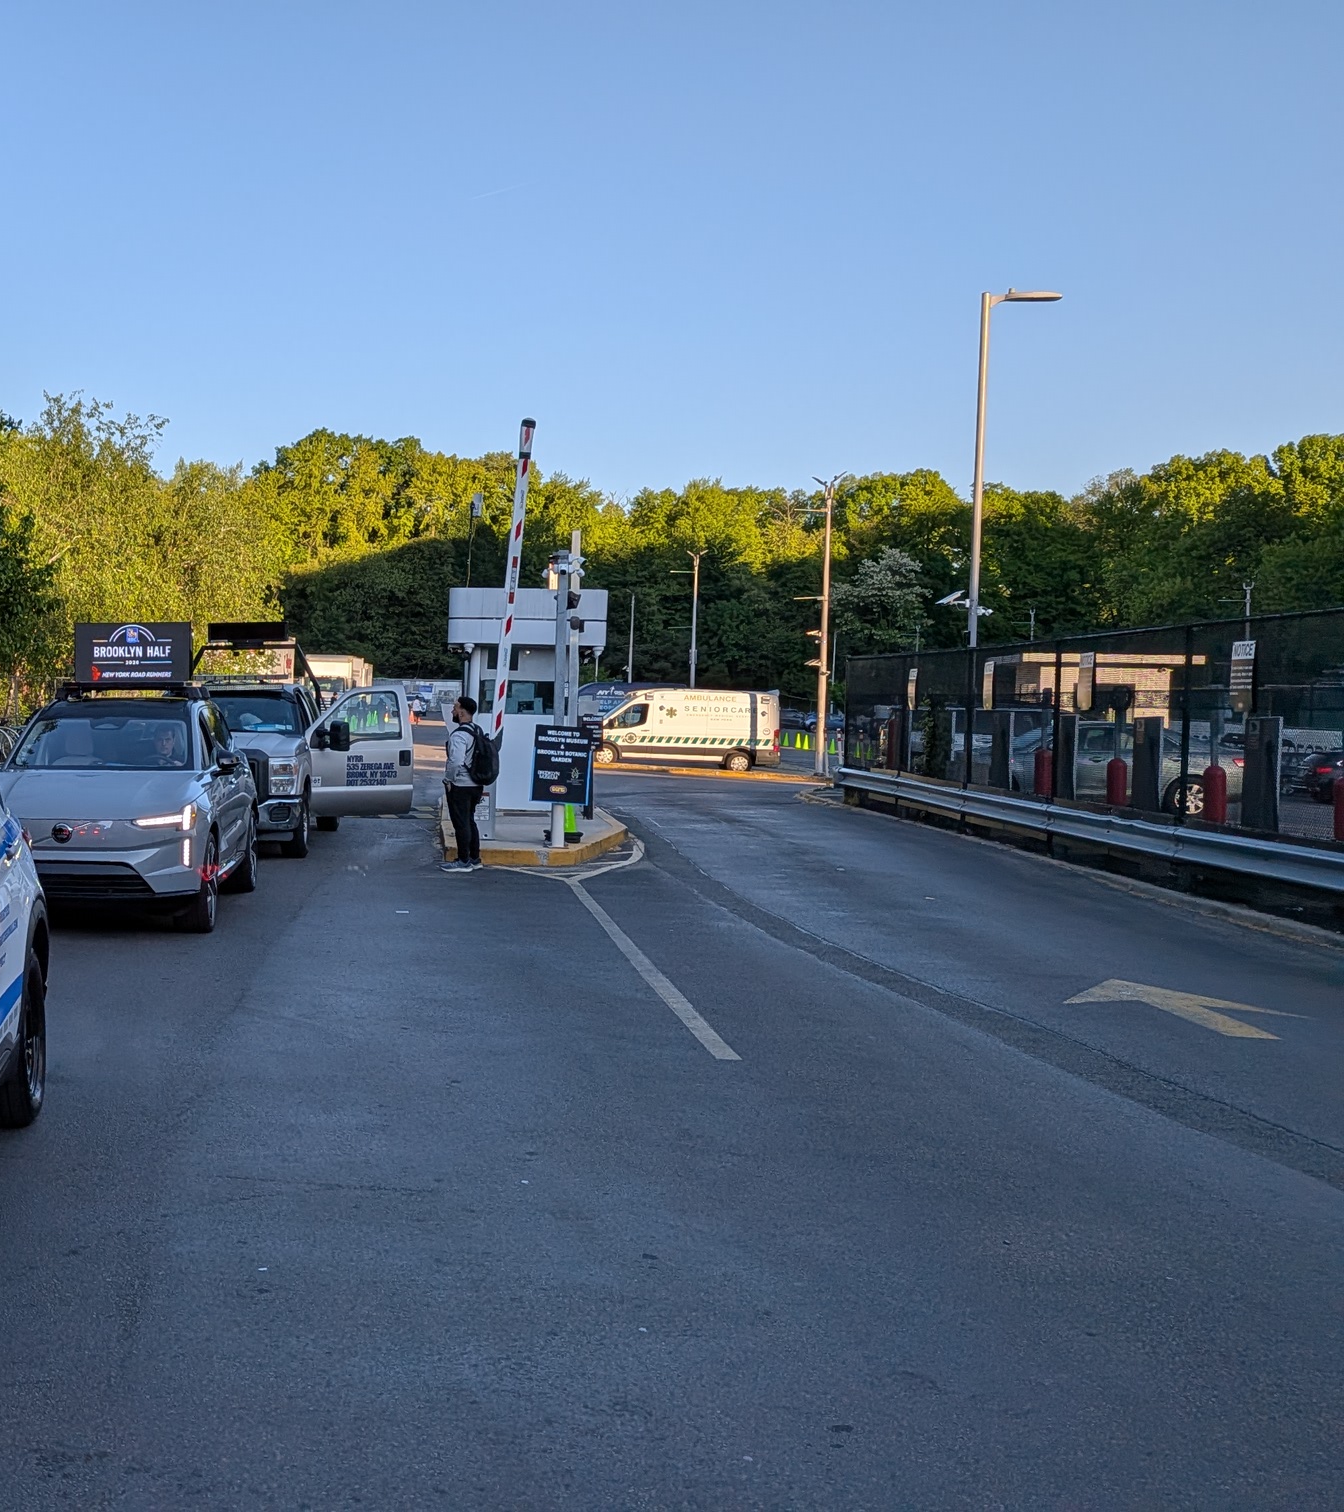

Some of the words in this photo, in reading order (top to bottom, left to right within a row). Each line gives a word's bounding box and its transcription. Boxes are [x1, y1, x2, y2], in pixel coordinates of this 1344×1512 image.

[93, 646, 143, 657] BROOKLYN
[147, 646, 172, 657] HALF
[1234, 643, 1253, 657] NOTICE
[684, 705, 759, 714] SENIORCARE
